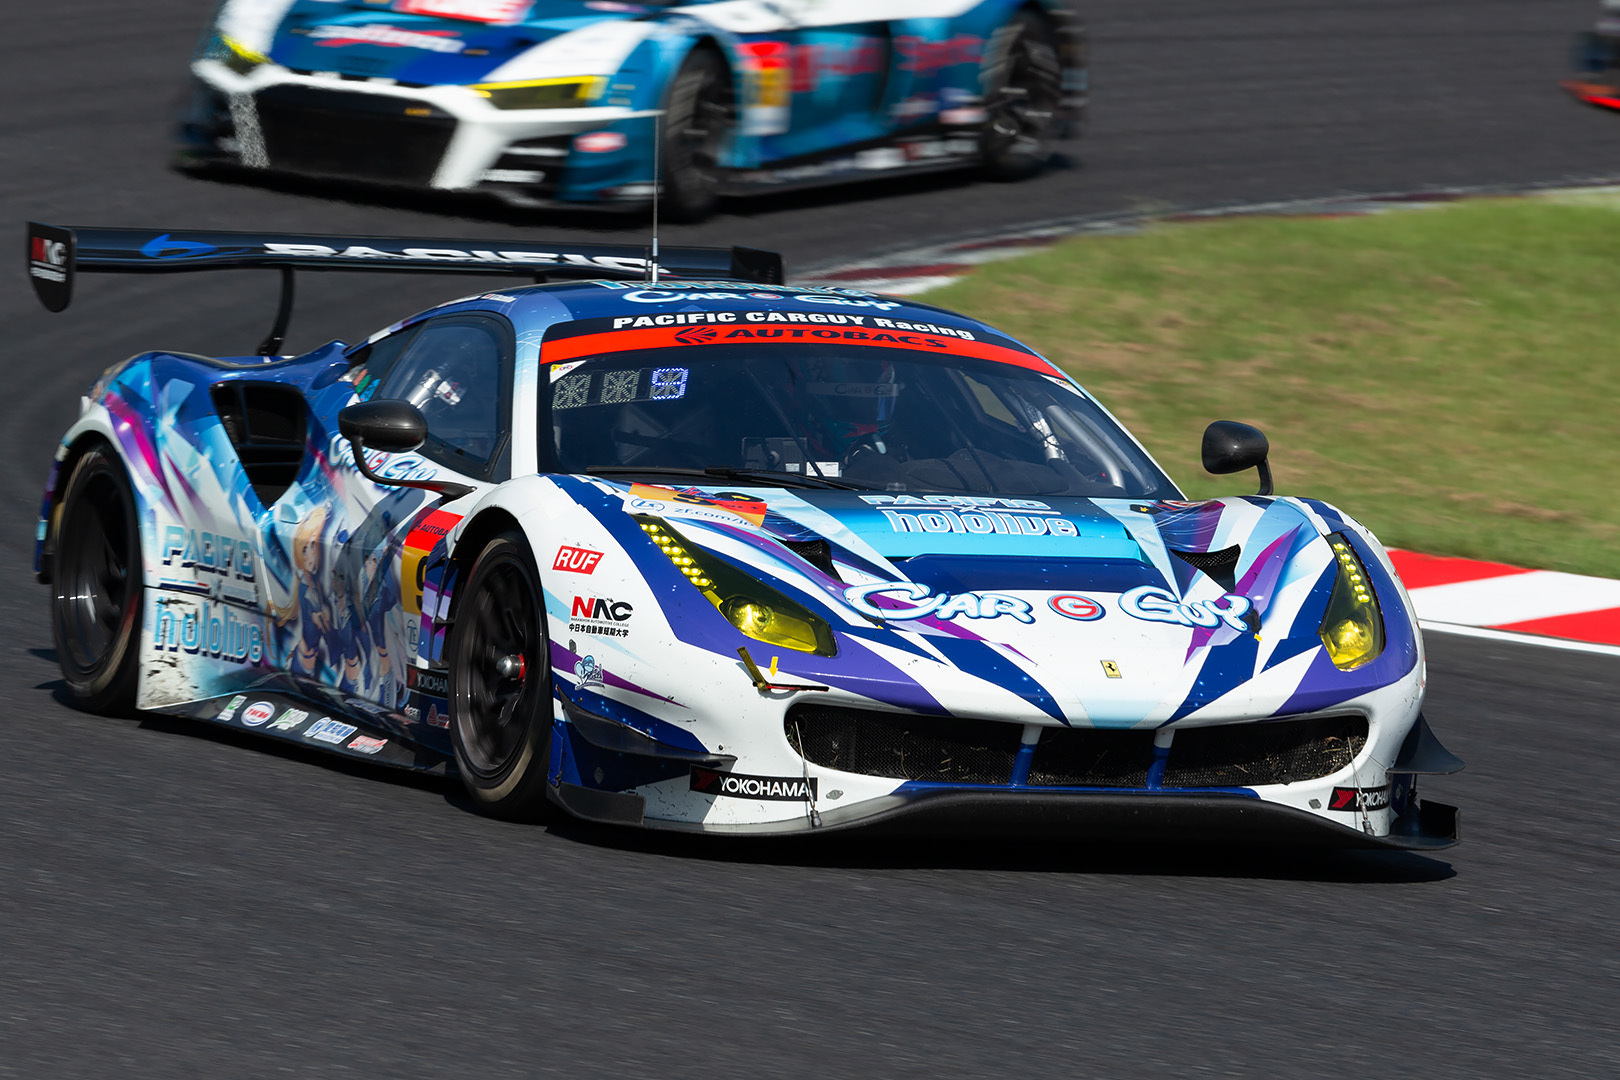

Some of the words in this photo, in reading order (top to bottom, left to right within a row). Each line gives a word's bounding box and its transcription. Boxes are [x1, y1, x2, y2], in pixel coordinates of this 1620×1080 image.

[613, 311, 737, 330] PACIFIC
[744, 311, 866, 327] CARGUY
[873, 317, 976, 341] Racing
[724, 328, 947, 349] AUTOBACS
[858, 495, 1051, 510] PACIFIC
[881, 510, 1078, 537] hololive
[555, 549, 600, 571] RUF
[571, 595, 634, 622] NAC
[153, 596, 264, 666] hololive
[719, 775, 812, 798] YOKOHAMA
